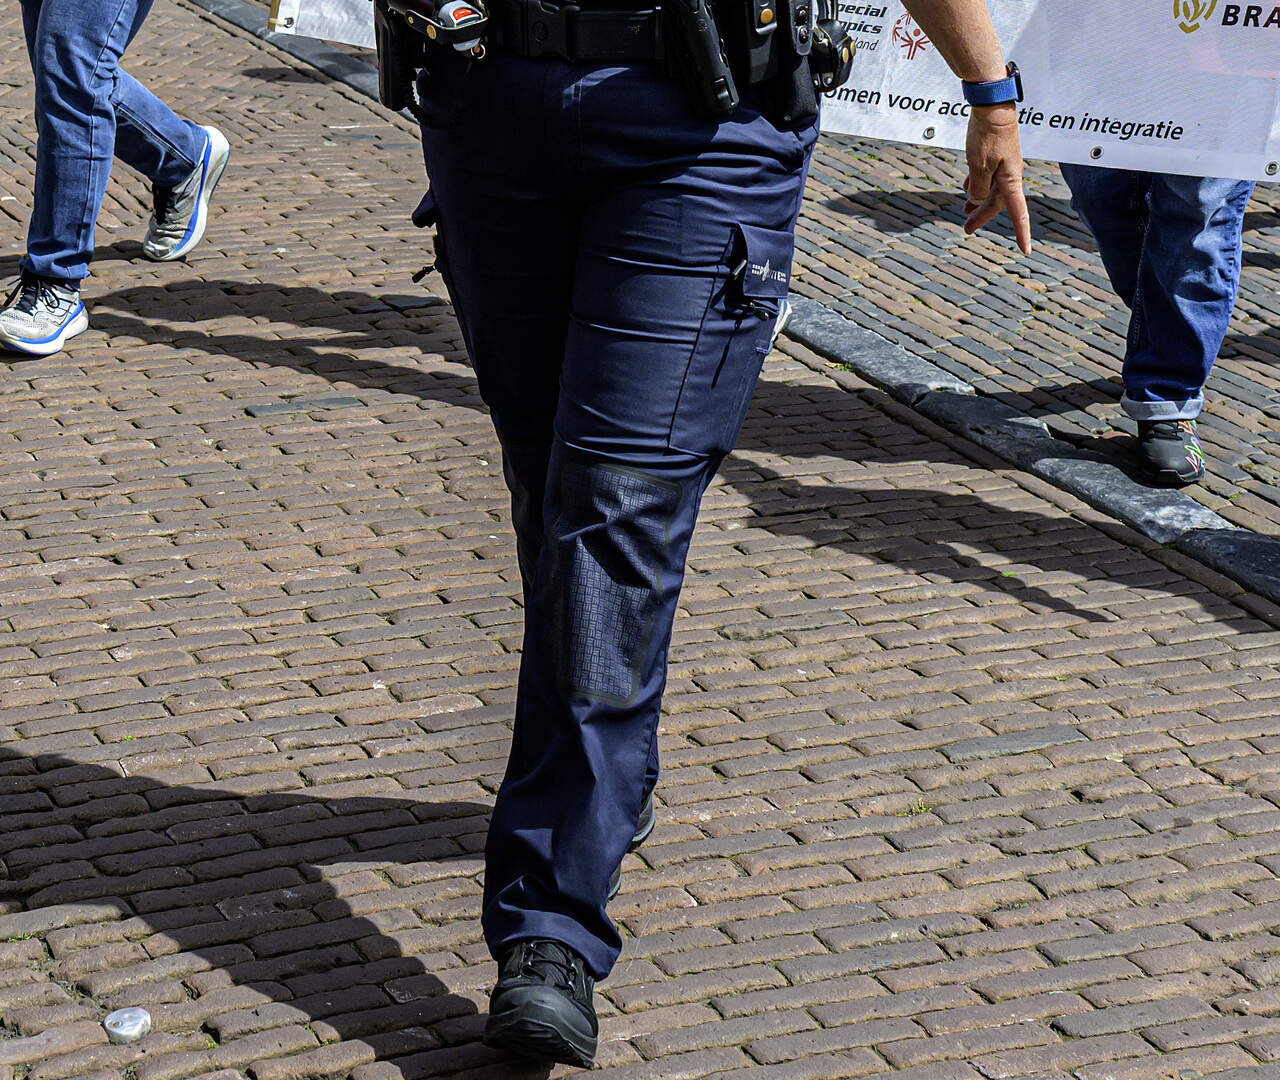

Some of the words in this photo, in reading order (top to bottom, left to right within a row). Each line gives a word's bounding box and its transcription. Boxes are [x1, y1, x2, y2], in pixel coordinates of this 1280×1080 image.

[888, 94, 935, 113] voor
[1048, 111, 1075, 130] en
[1079, 110, 1185, 142] integratie
